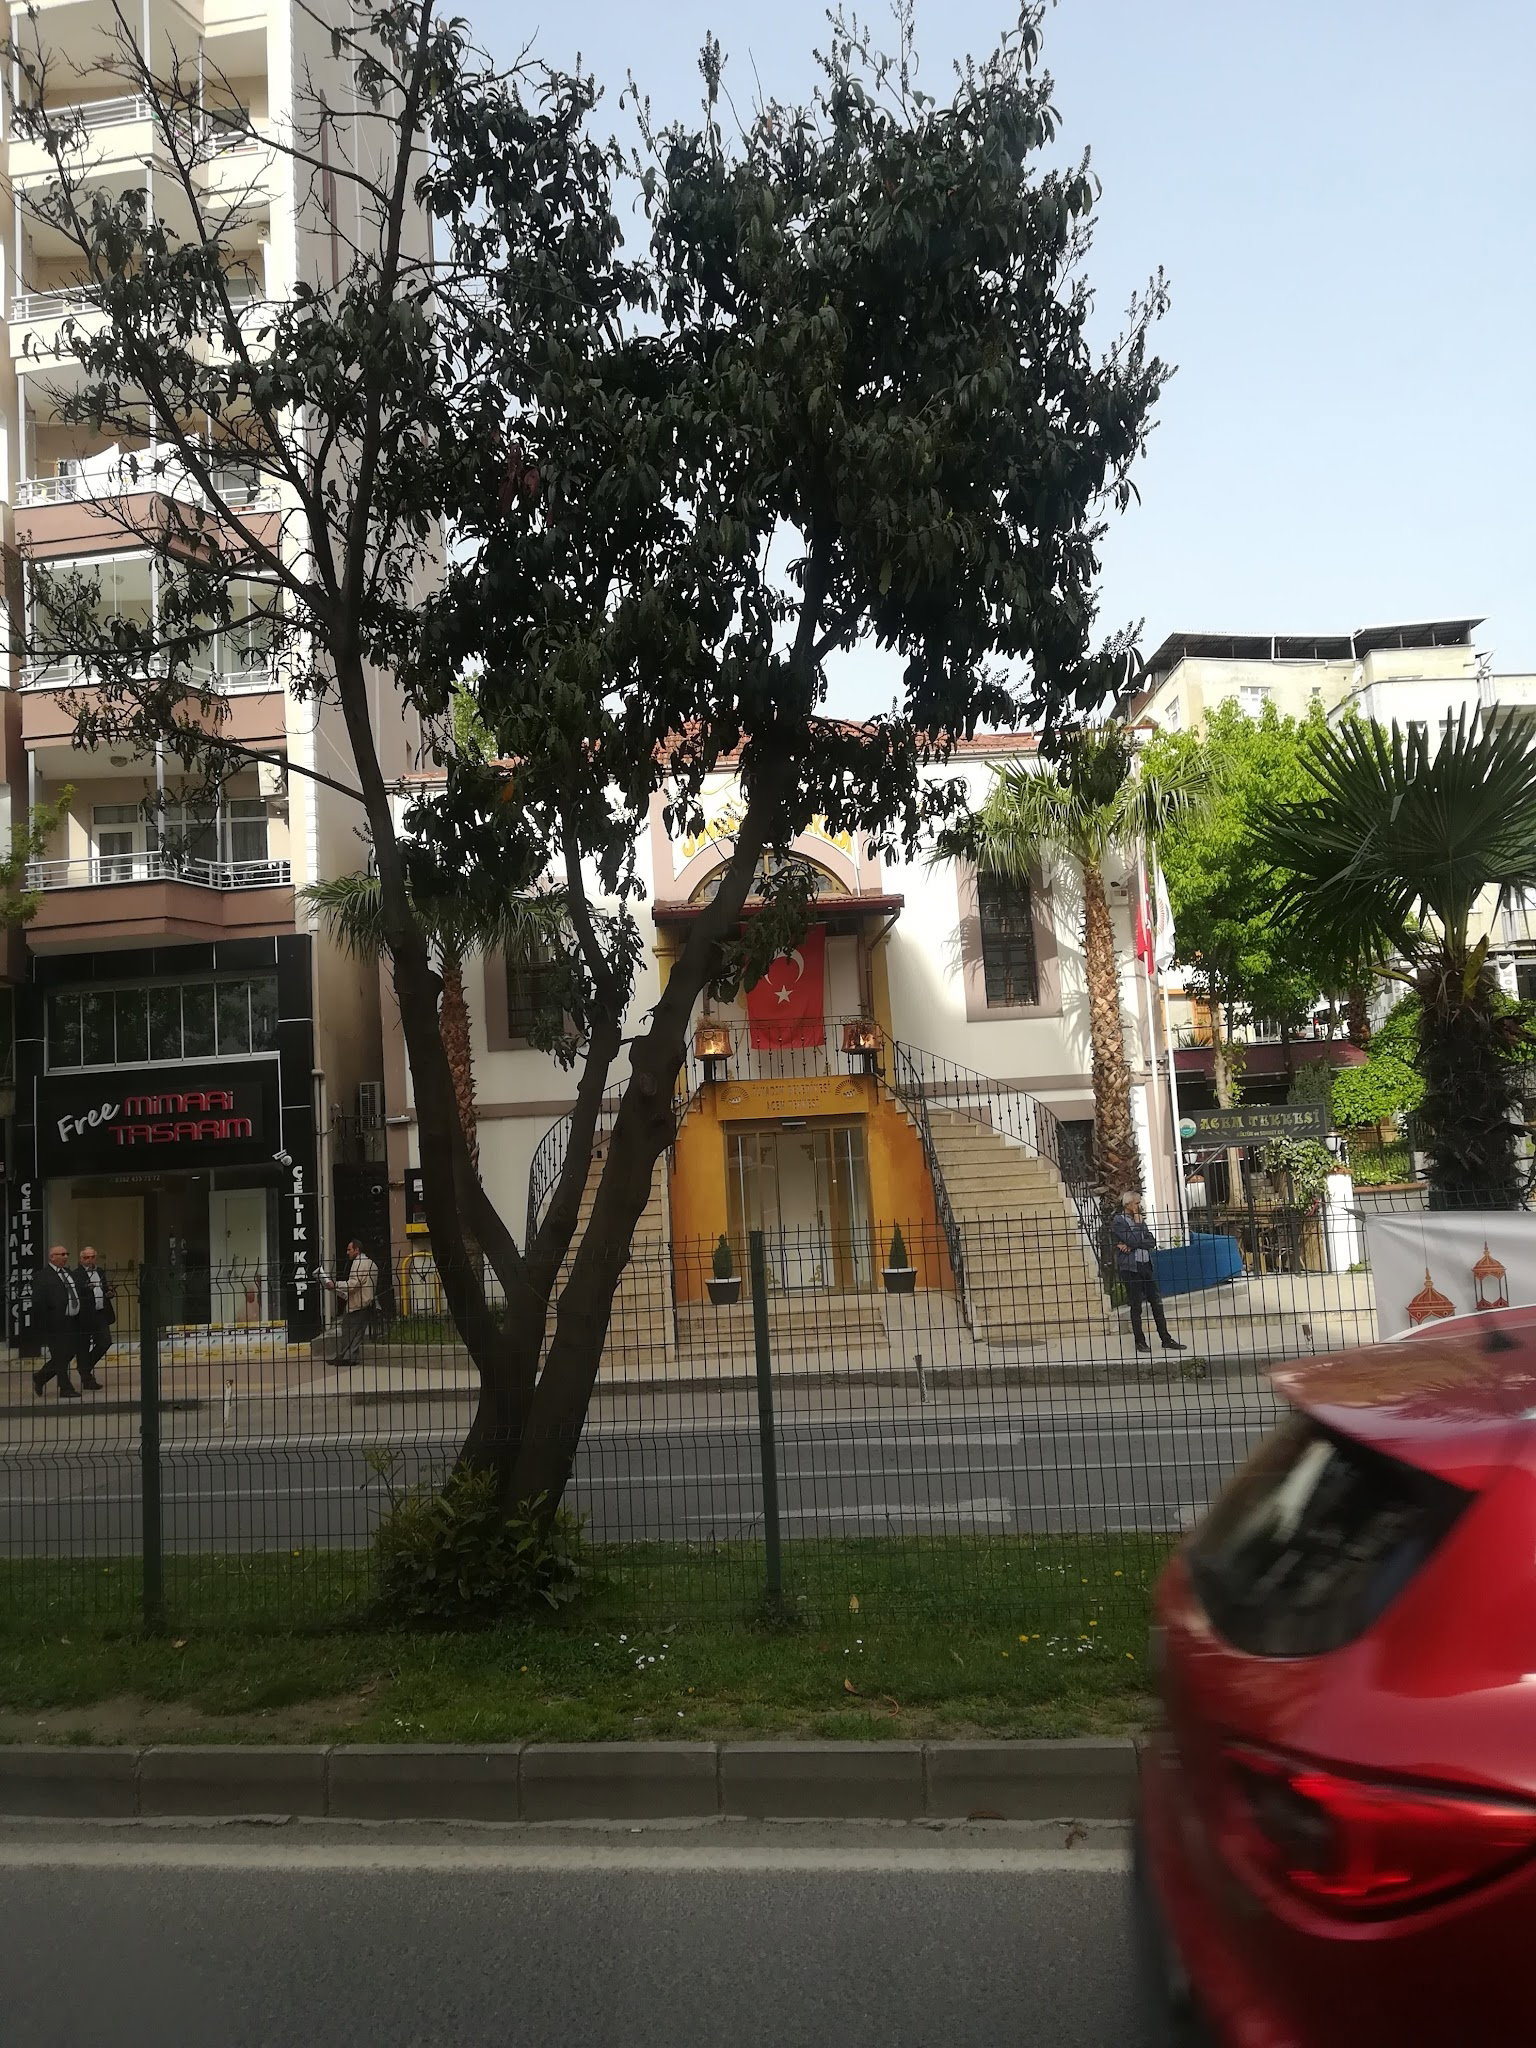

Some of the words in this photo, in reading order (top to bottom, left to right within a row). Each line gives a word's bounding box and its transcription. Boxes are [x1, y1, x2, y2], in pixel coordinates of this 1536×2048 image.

[57, 1102, 121, 1143] Free
[108, 1118, 252, 1145] TASARIM
[20, 1182, 34, 1256] ÇELİK
[292, 1165, 307, 1241] ÇELİK
[20, 1268, 34, 1327] KAPI
[293, 1251, 308, 1311] KAPI
